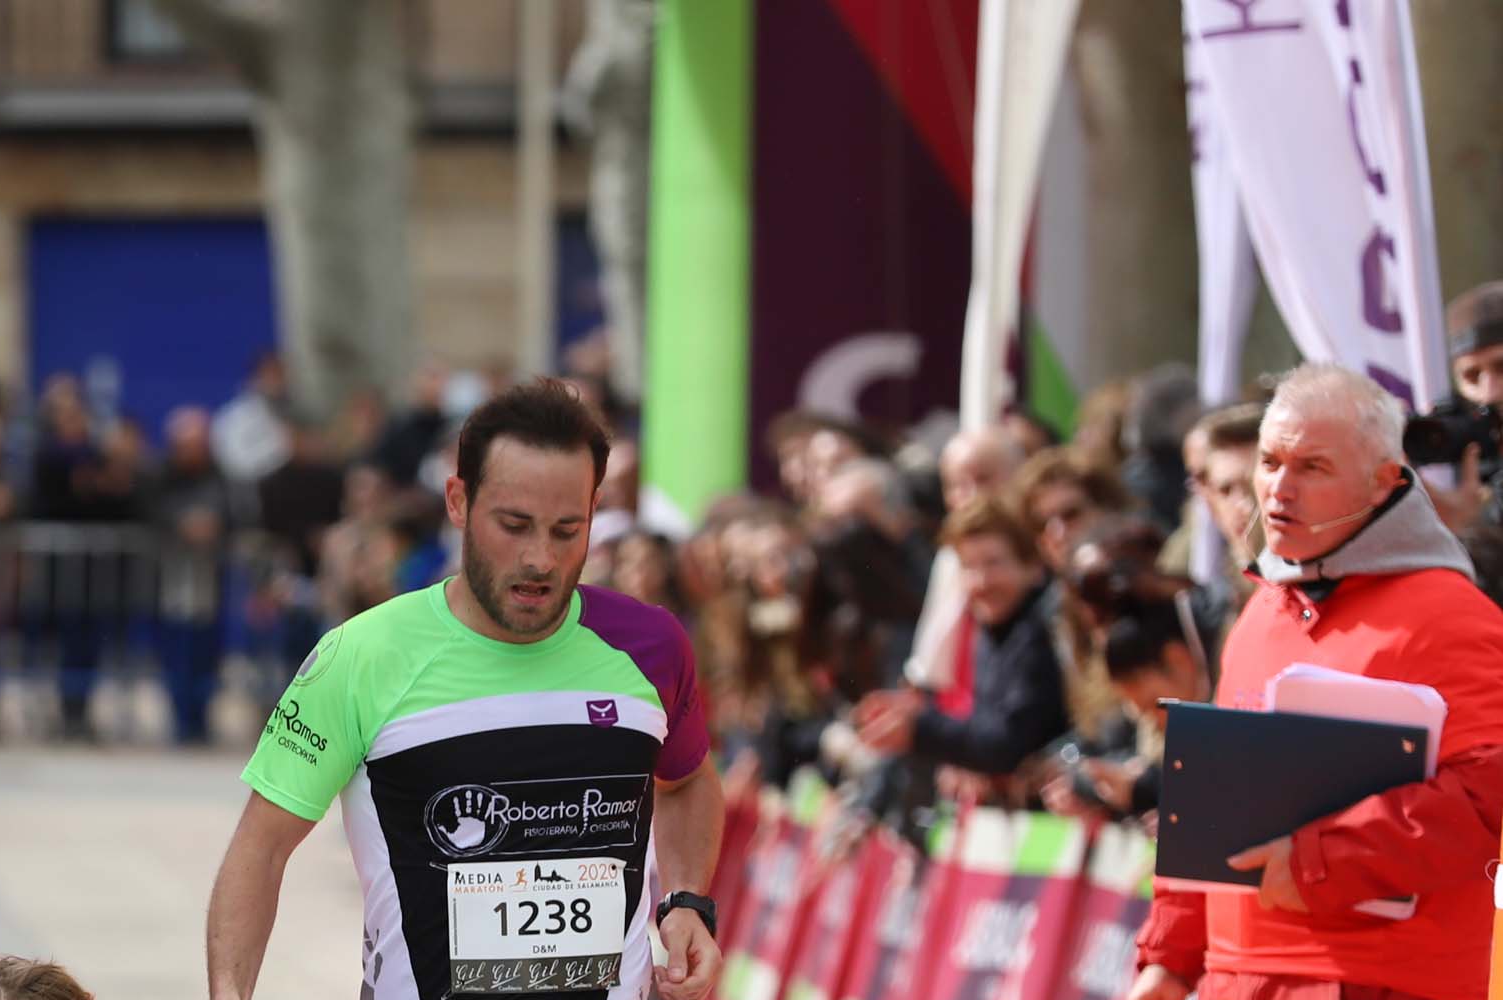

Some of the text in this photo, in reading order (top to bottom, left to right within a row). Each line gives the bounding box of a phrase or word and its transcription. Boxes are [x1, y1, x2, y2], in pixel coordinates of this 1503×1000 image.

[282, 699, 328, 752] Ramos
[484, 788, 637, 825] Roberto Ramos
[454, 871, 504, 885] MEDIA
[578, 863, 618, 881] 2020
[532, 883, 562, 892] CIUDAD
[577, 881, 619, 890] SALAMANCA
[493, 897, 593, 937] 1238
[532, 944, 557, 954] D&M
